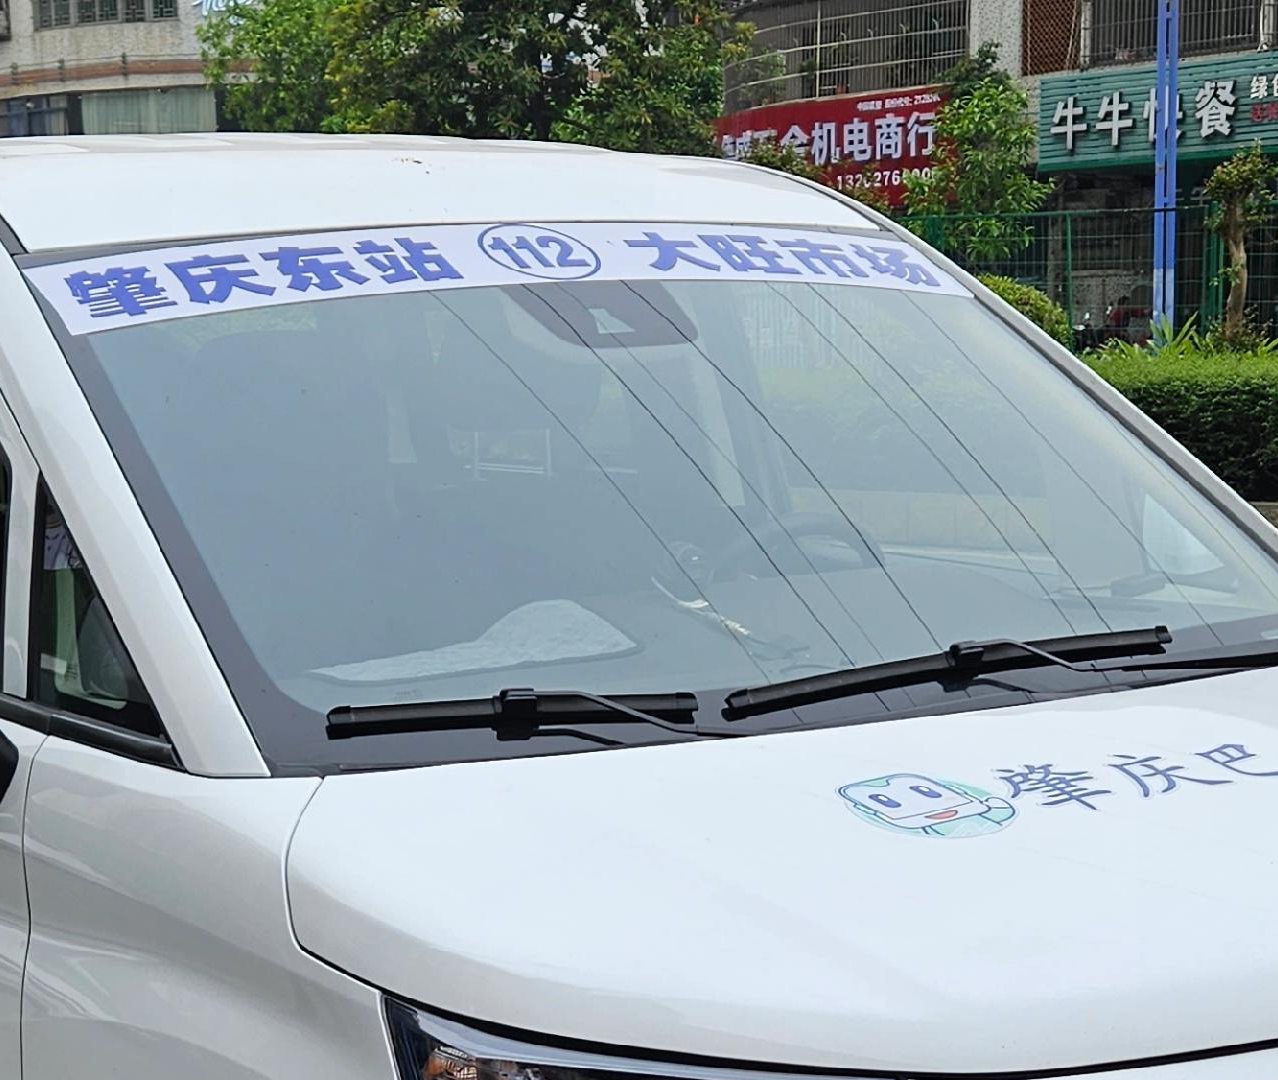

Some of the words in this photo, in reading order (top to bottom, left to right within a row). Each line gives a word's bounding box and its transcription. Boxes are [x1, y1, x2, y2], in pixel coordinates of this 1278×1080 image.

[64, 237, 463, 318] 肇庆东站
[489, 235, 589, 269] 112
[624, 232, 940, 287] 大旺市场
